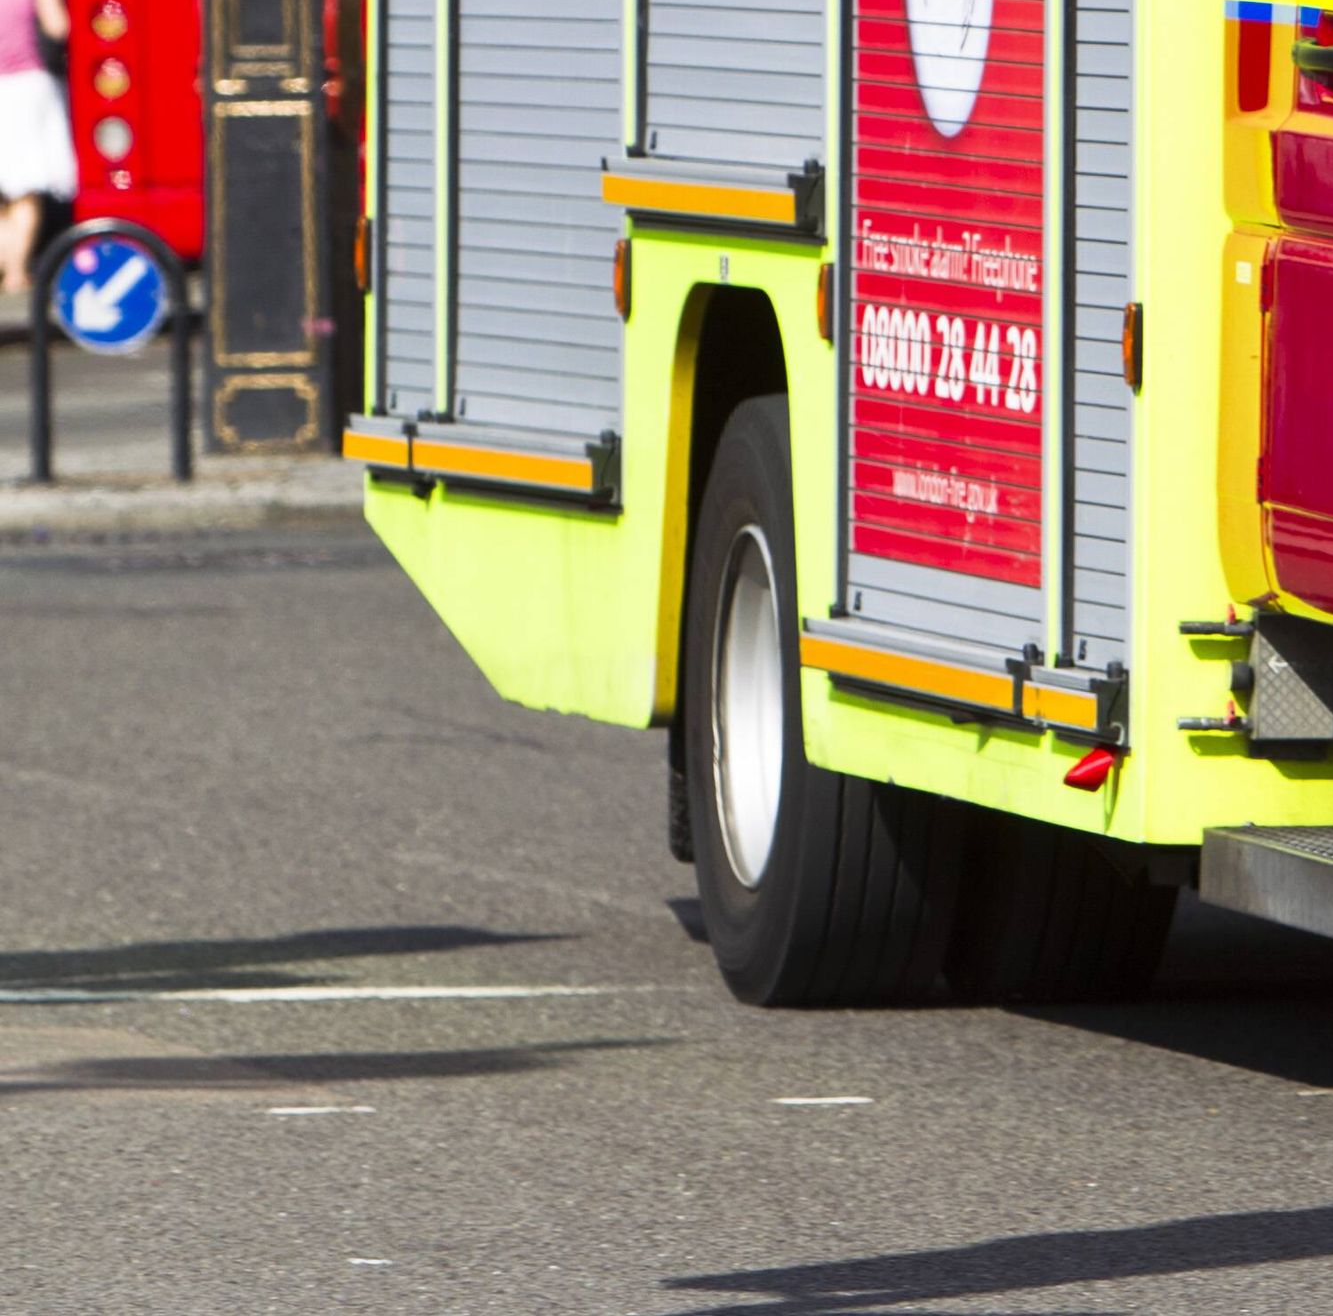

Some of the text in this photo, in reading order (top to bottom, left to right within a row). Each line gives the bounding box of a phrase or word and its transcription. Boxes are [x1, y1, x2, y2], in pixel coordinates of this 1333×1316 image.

[862, 219, 889, 271] Free
[889, 222, 929, 277] smoke
[971, 232, 1038, 304] Freephone
[861, 303, 1037, 414] 08000 28 44 28
